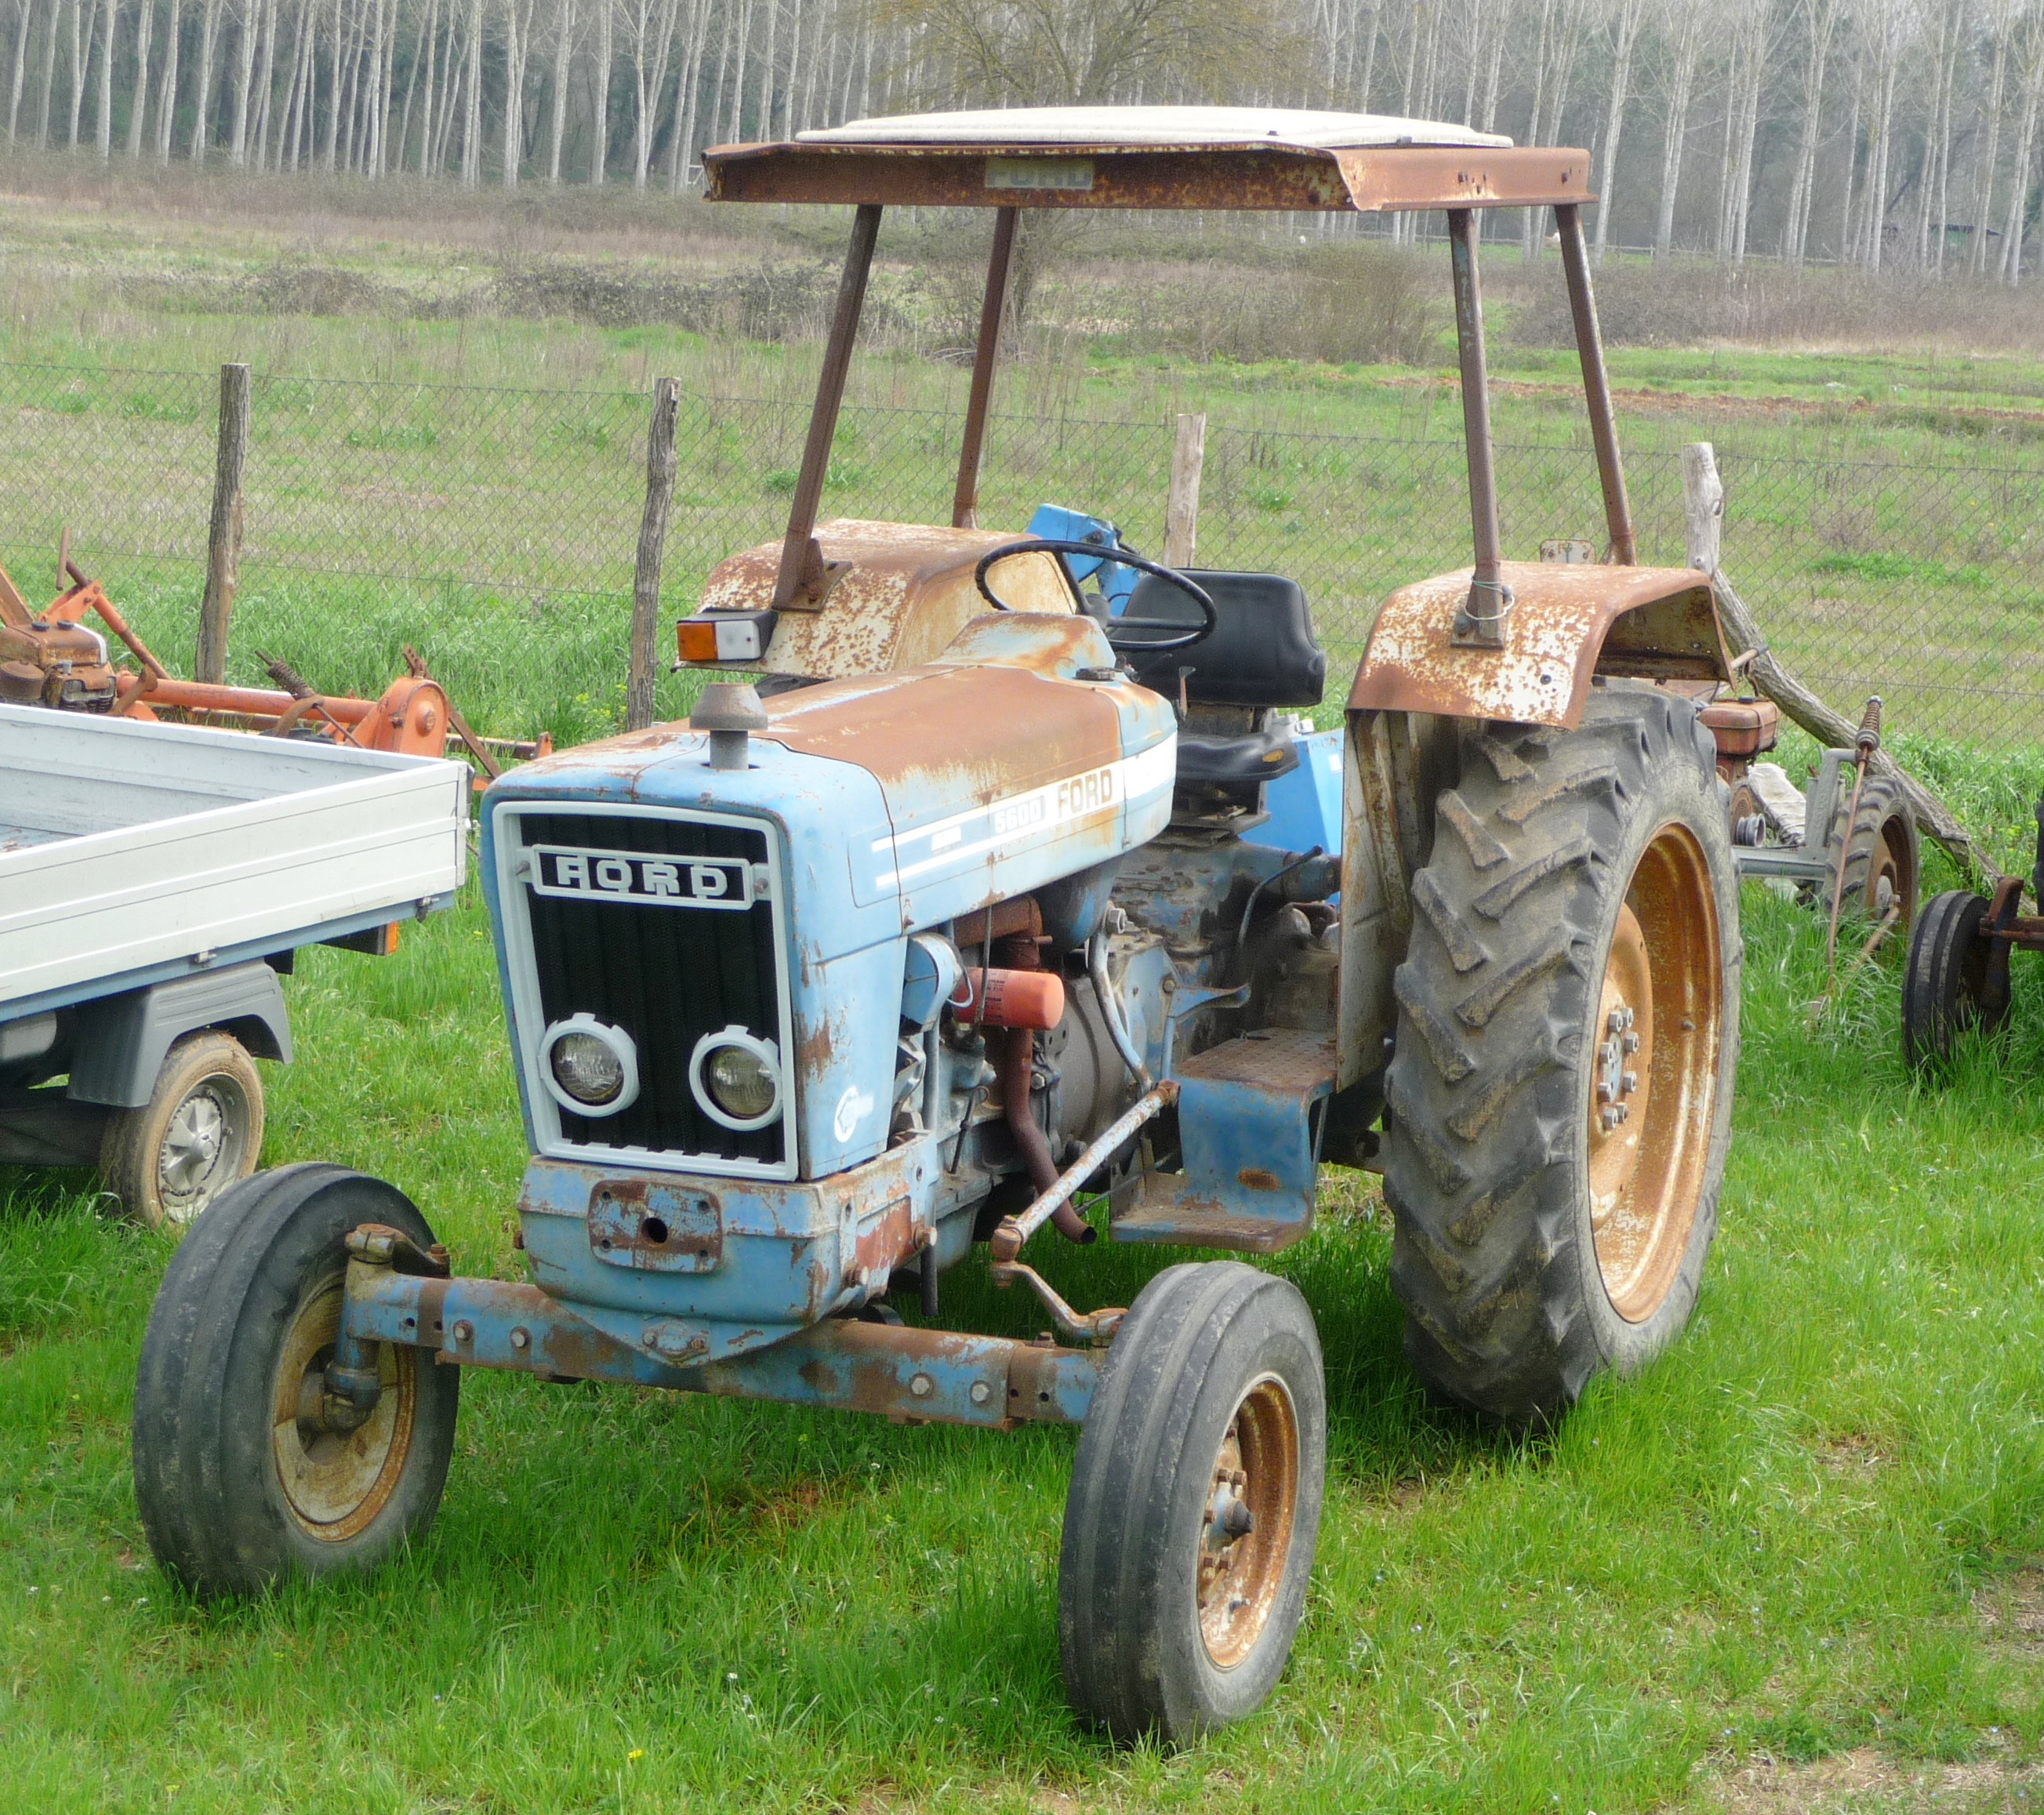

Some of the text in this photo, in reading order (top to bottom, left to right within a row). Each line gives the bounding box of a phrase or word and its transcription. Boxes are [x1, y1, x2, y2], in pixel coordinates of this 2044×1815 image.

[995, 769, 1113, 834] 5600 FORD
[556, 856, 728, 897] FORD
